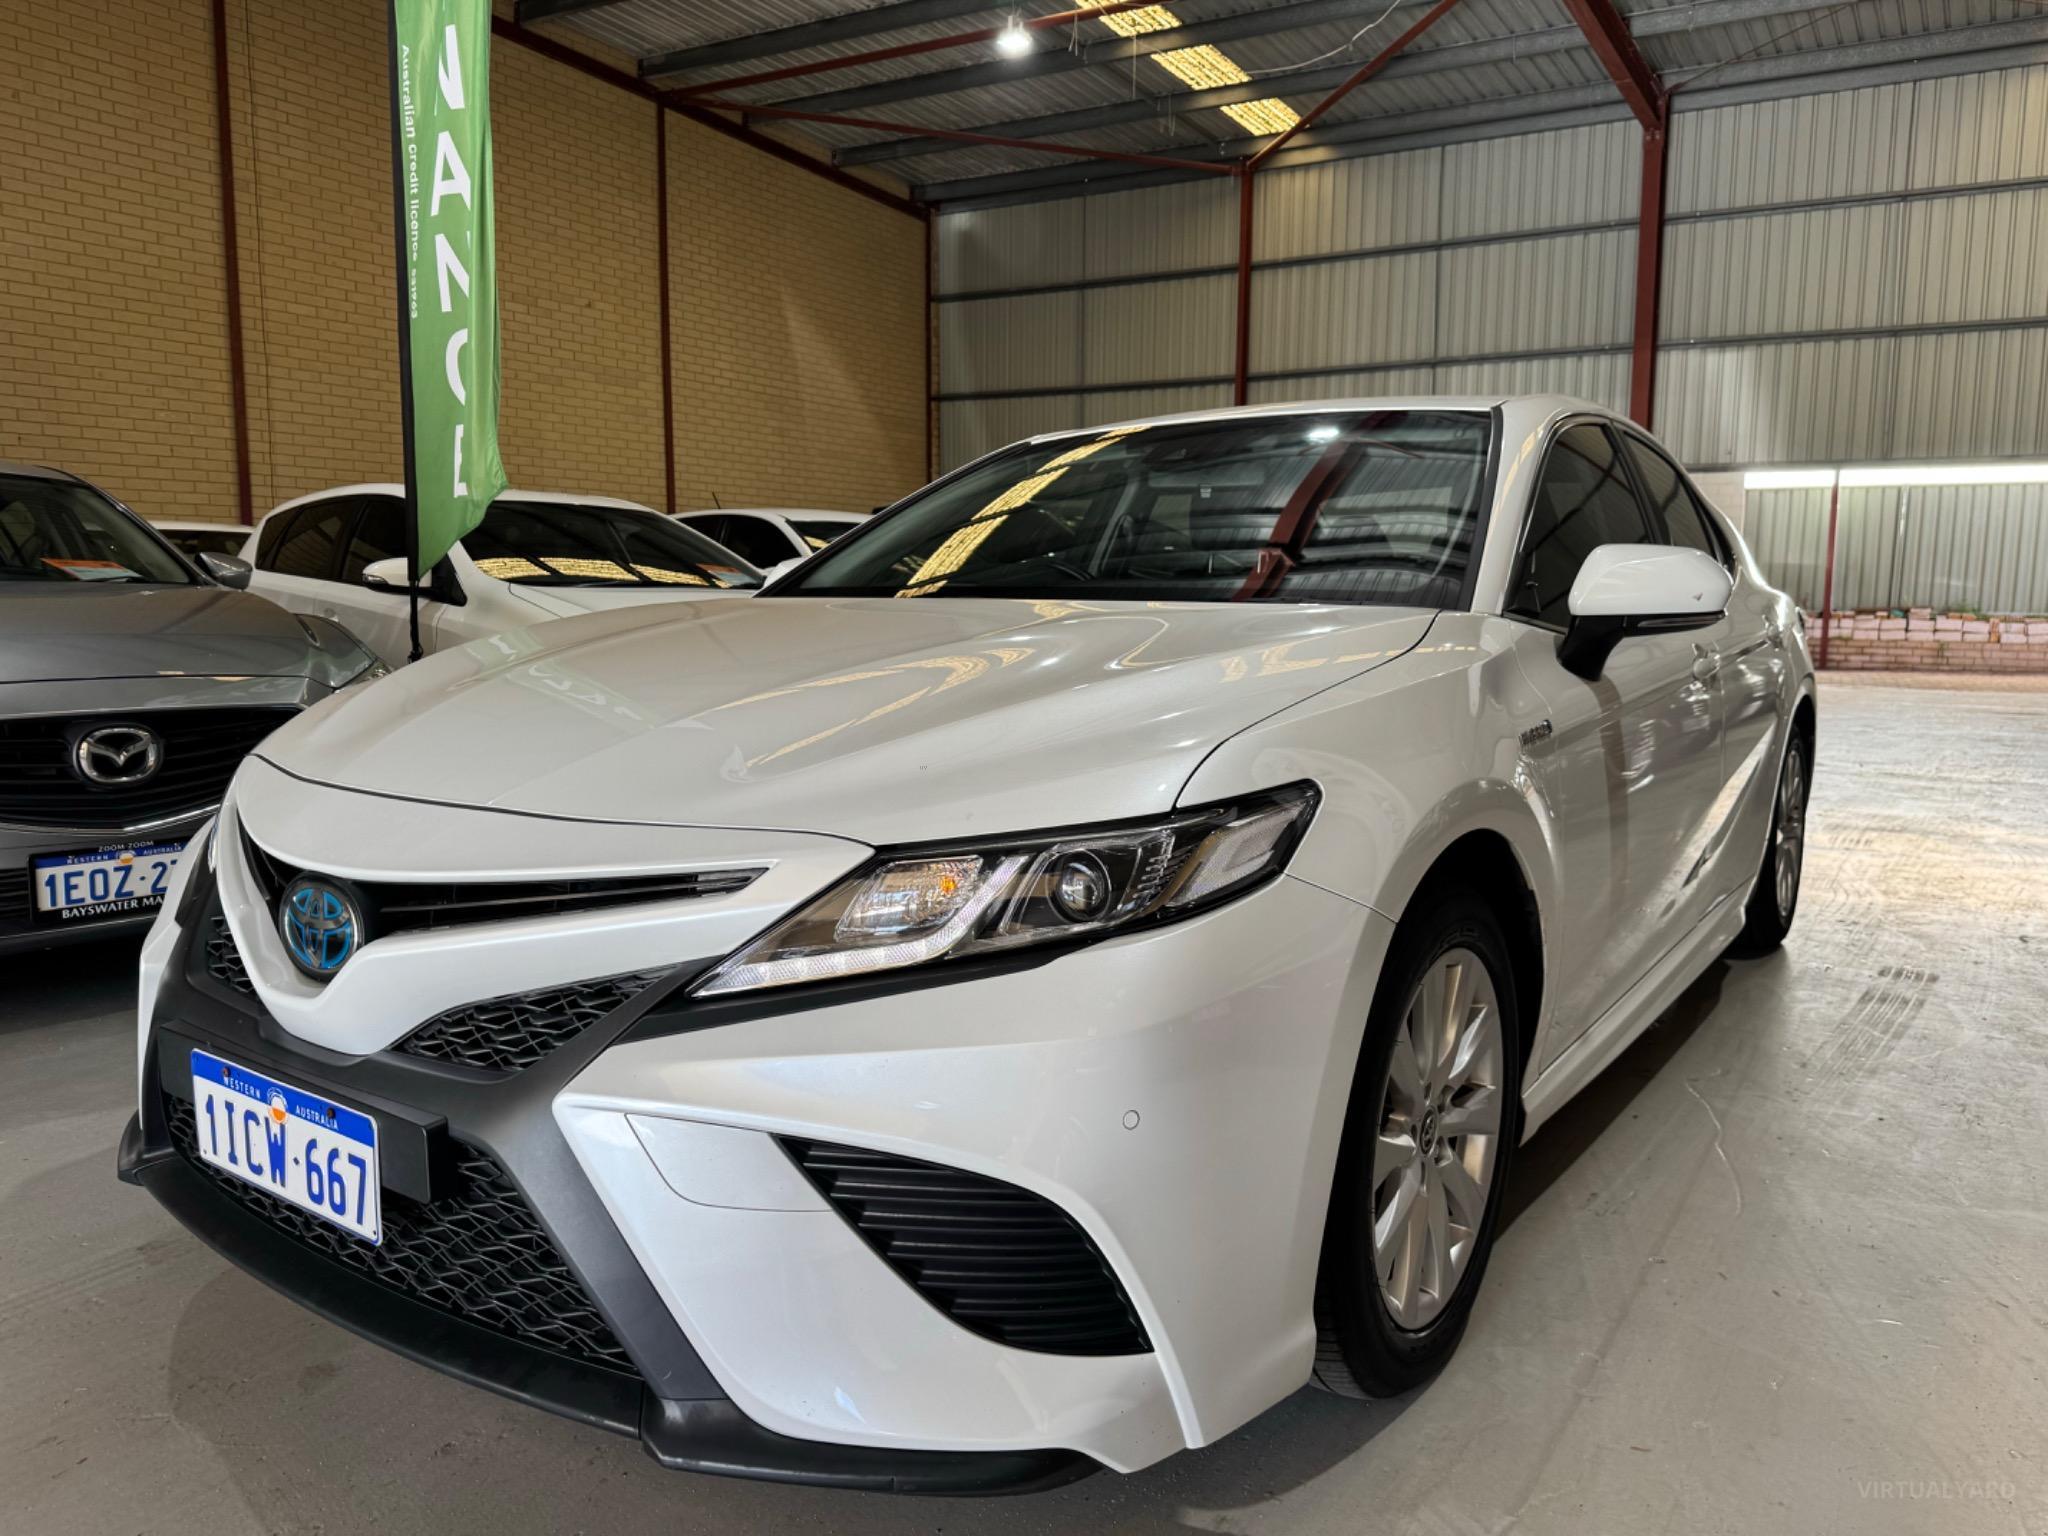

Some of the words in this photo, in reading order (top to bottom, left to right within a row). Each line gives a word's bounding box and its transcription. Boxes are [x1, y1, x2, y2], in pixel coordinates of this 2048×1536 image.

[401, 44, 416, 139] Australian
[408, 144, 418, 195] credit
[410, 200, 420, 261] licence
[62, 899, 140, 920] BAYSWATER
[223, 1075, 261, 1100] WESTERN
[295, 1104, 339, 1131] AUSTRALIA
